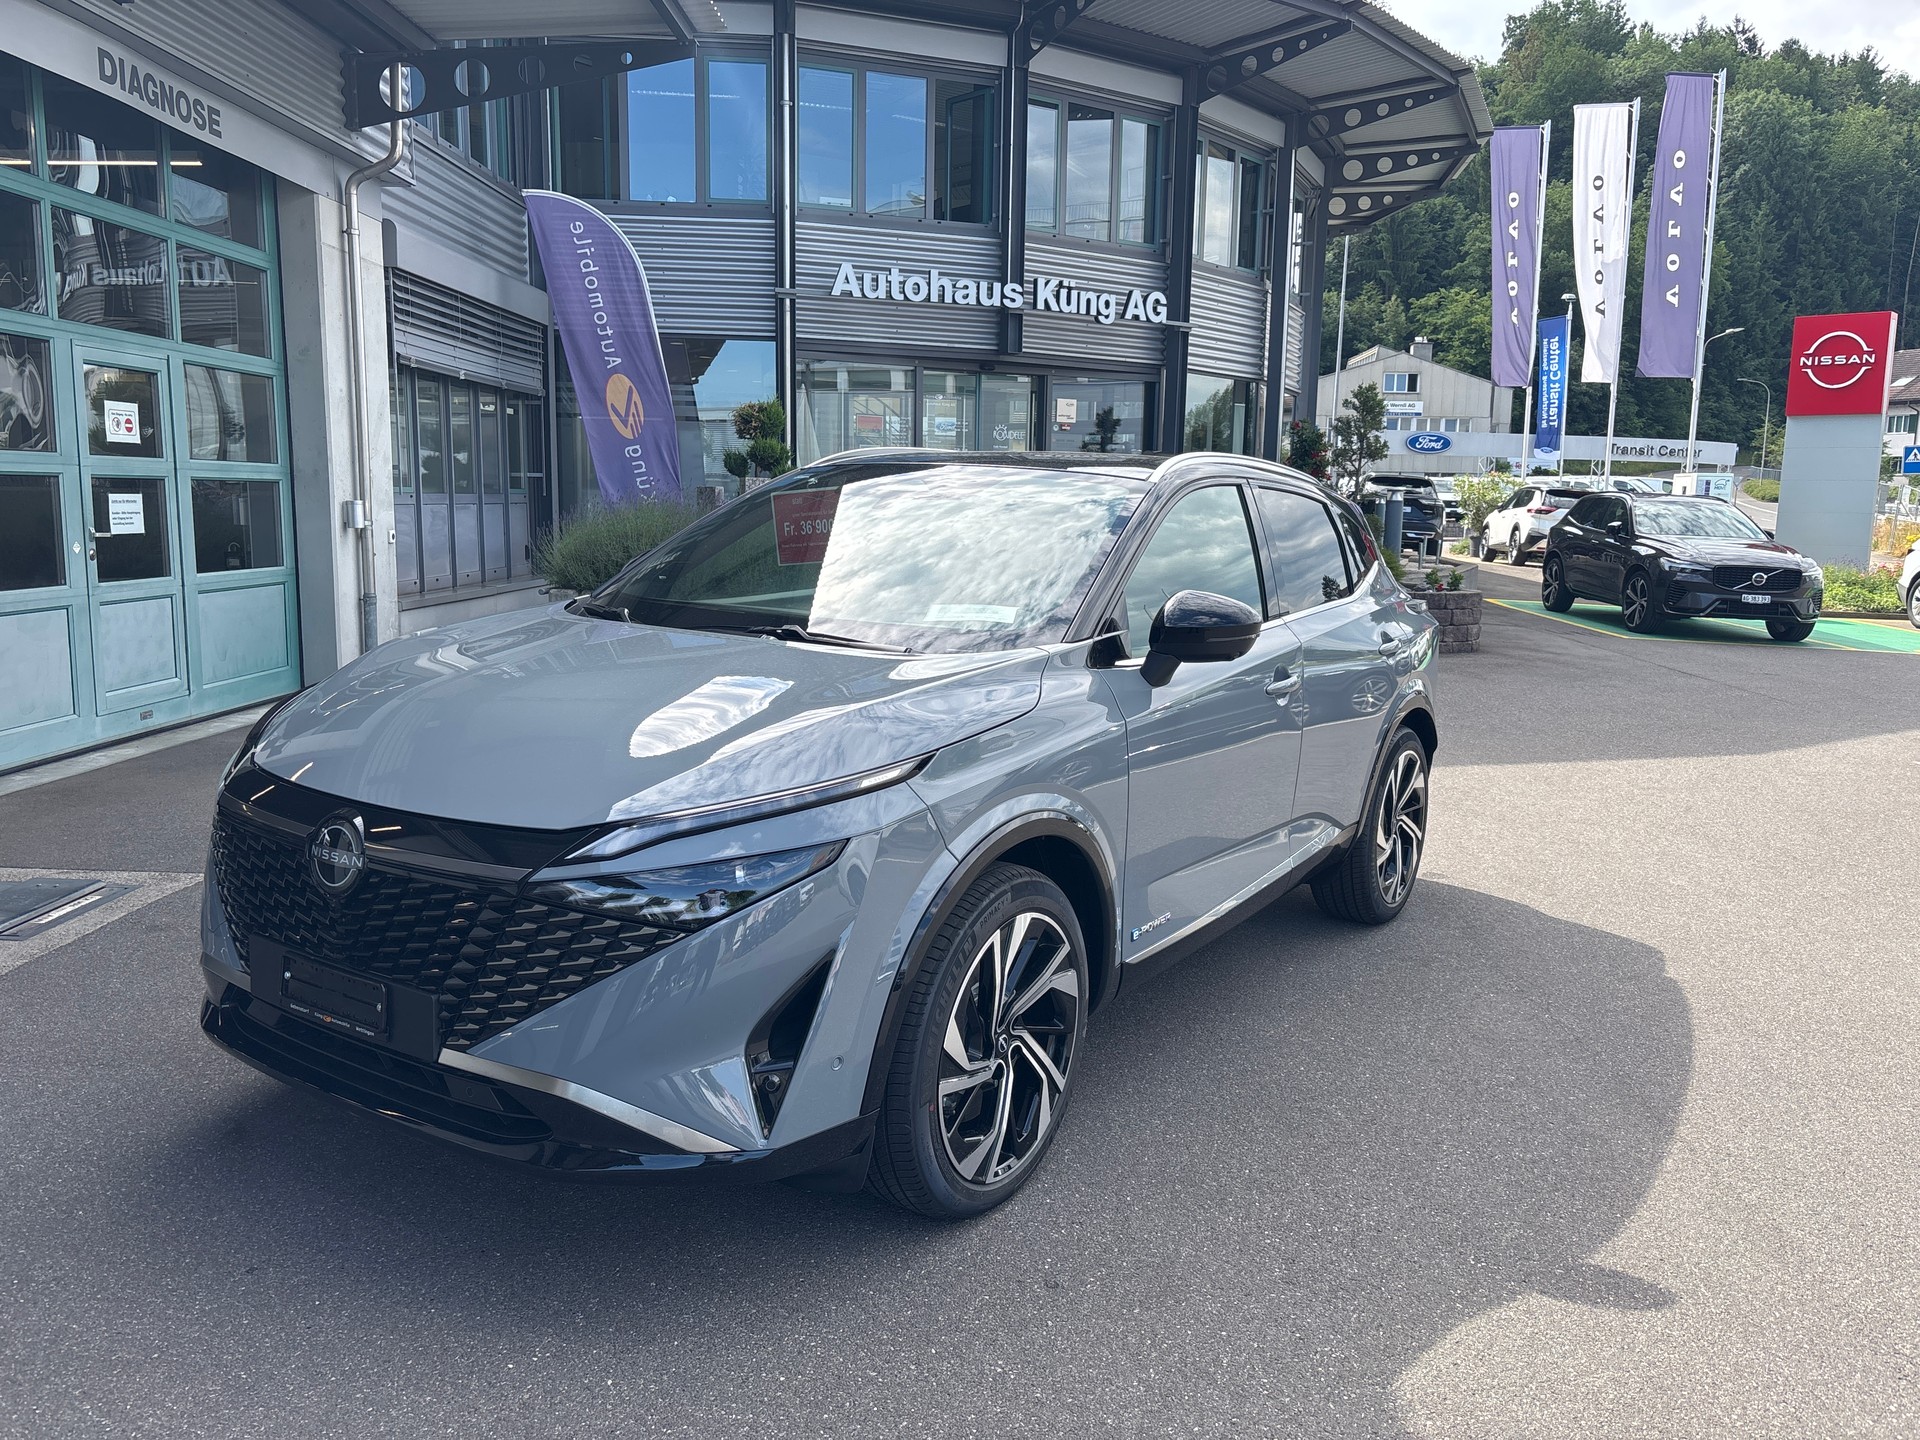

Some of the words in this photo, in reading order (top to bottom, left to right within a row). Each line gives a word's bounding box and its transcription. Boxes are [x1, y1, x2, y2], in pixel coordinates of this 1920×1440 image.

[97, 46, 222, 139] DIAGNOSE
[831, 262, 1024, 309] Autohaus
[1034, 277, 1116, 325] Küng
[1122, 289, 1167, 324] AG
[1800, 354, 1876, 366] NISSAN
[1415, 435, 1444, 449] Ford
[1611, 443, 1654, 457] Transit
[784, 522, 798, 537] Fr.
[311, 845, 363, 867] NISSAN
